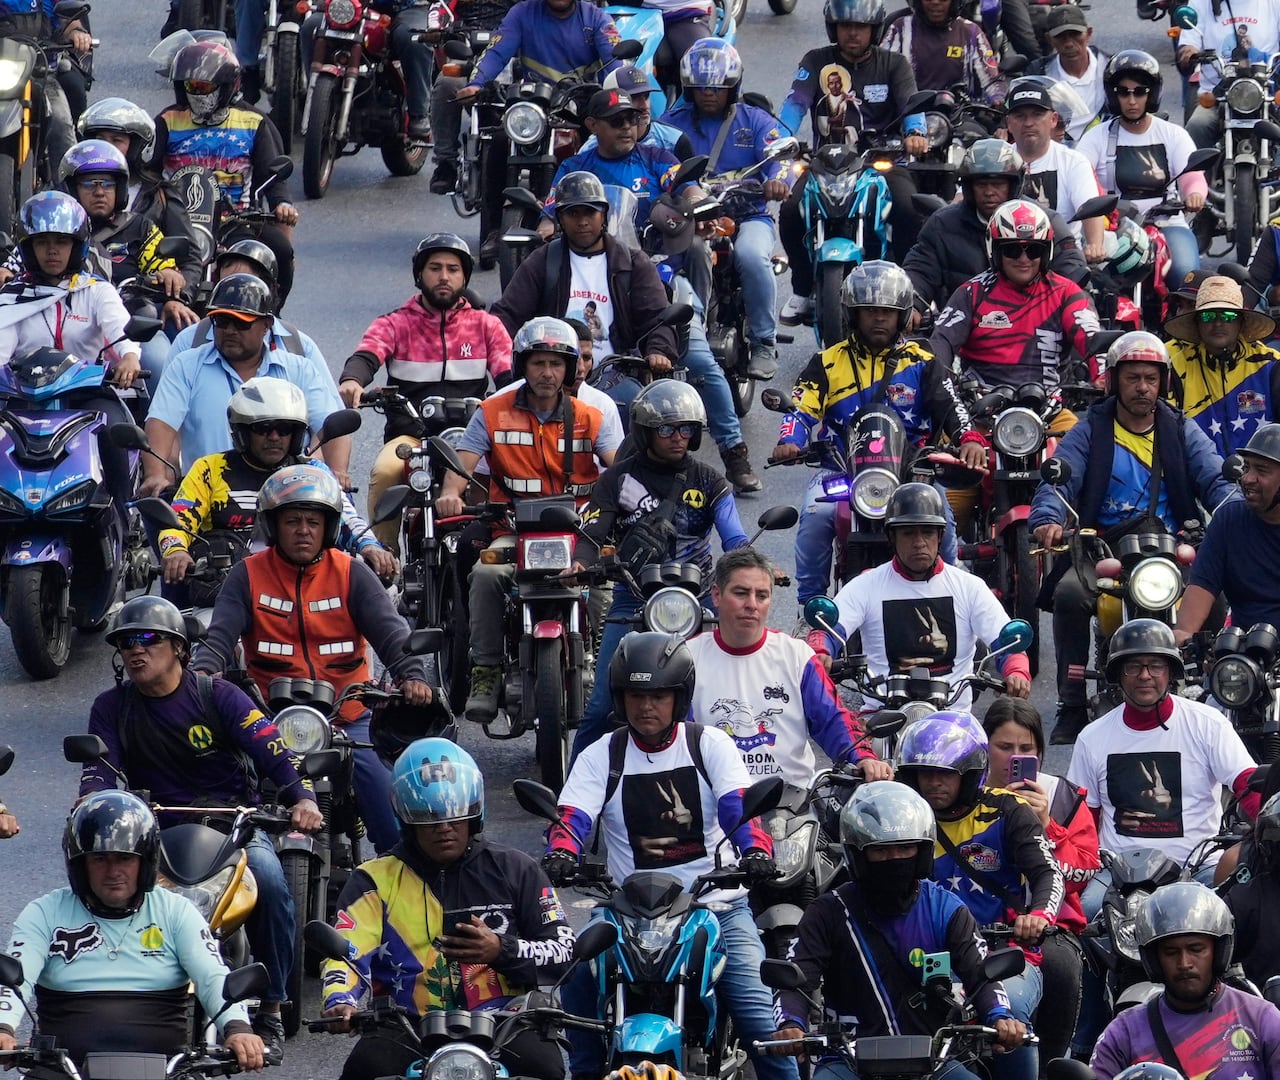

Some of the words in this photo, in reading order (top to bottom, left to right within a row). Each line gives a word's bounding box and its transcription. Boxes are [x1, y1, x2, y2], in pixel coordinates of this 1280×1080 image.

[1222, 17, 1258, 26] LIBERTAD
[946, 46, 963, 58] 13
[570, 290, 608, 303] LIBERTAD
[749, 766, 783, 777] ZUELA
